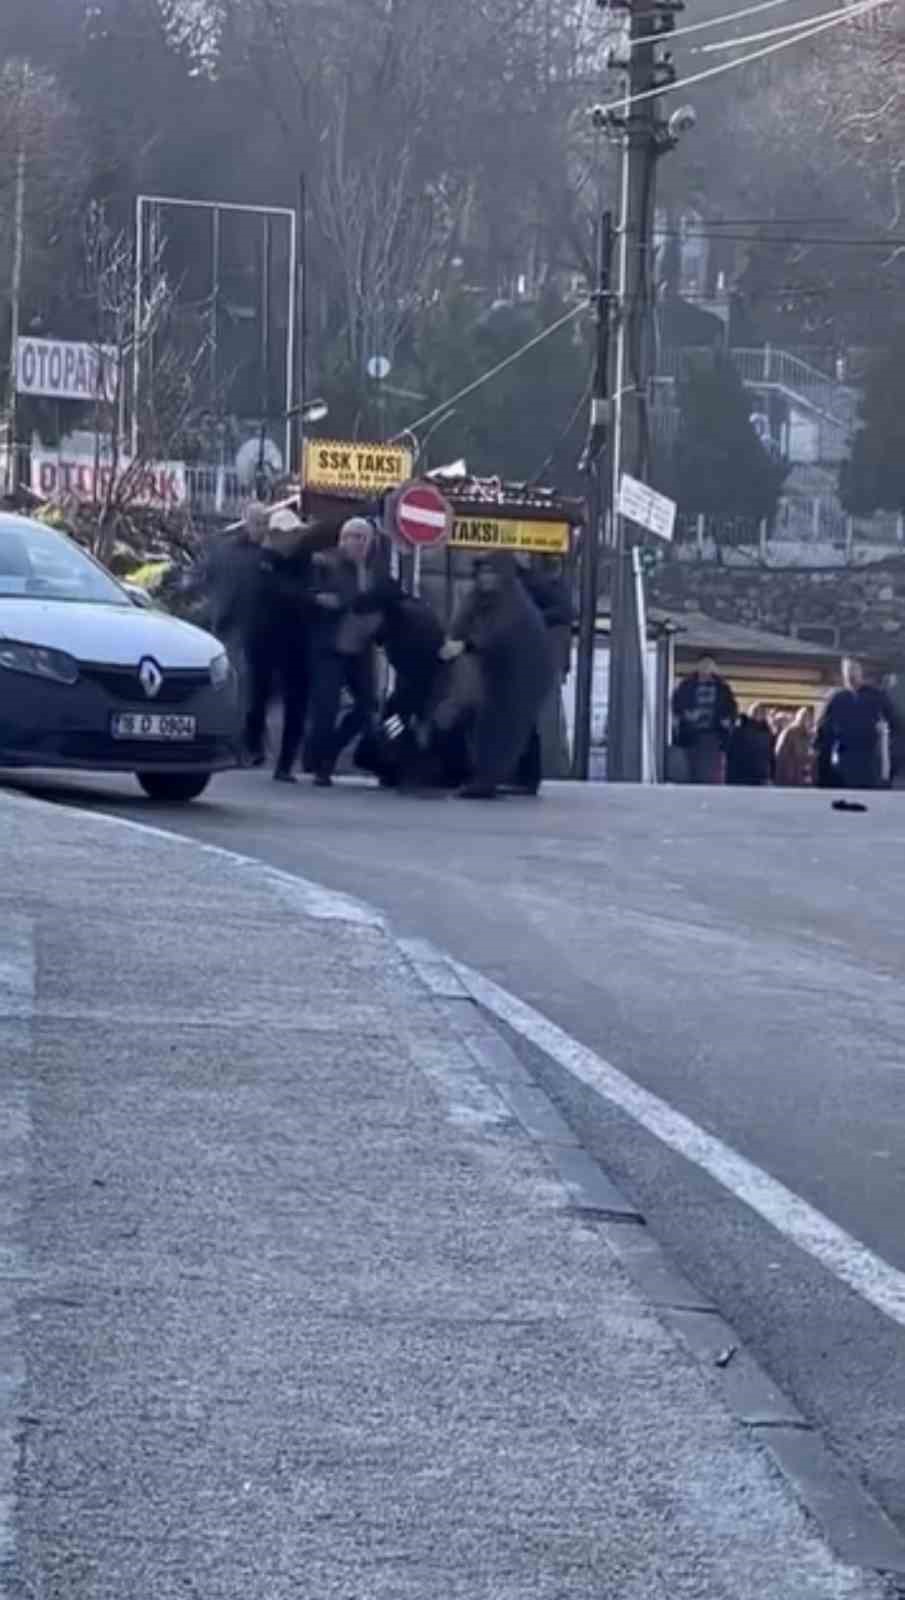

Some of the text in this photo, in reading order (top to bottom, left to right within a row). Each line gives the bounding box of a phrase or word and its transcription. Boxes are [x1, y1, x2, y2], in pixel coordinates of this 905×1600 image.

[22, 344, 115, 396] OTOPAR
[319, 449, 402, 474] SSK TAKSI
[448, 520, 499, 542] TAKSI
